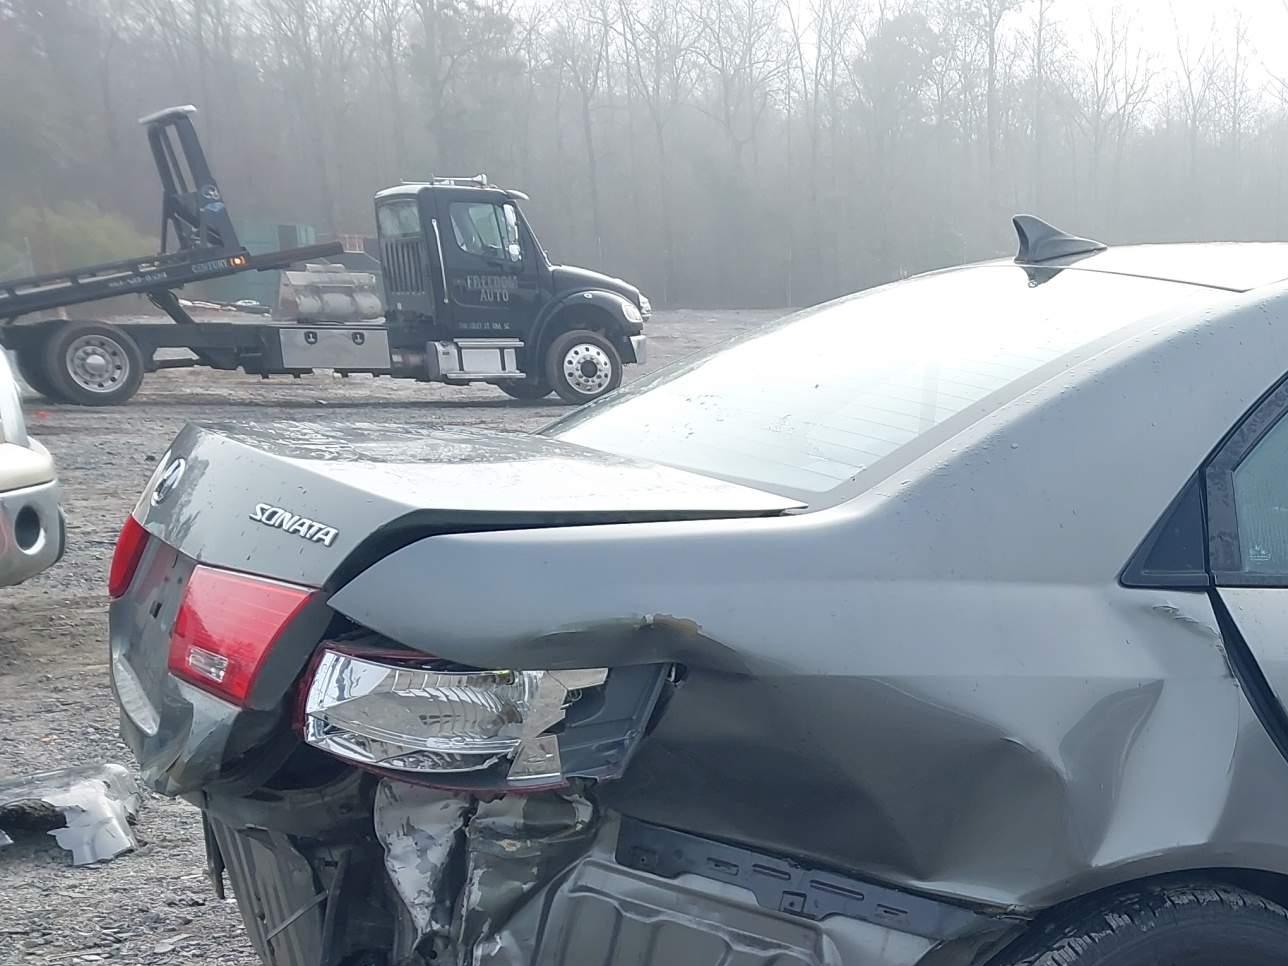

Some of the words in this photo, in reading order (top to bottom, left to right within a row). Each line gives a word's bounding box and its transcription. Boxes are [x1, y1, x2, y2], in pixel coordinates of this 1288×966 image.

[466, 275, 519, 289] FREEDOM
[480, 288, 510, 302] AUTO
[249, 503, 339, 547] SONATA
